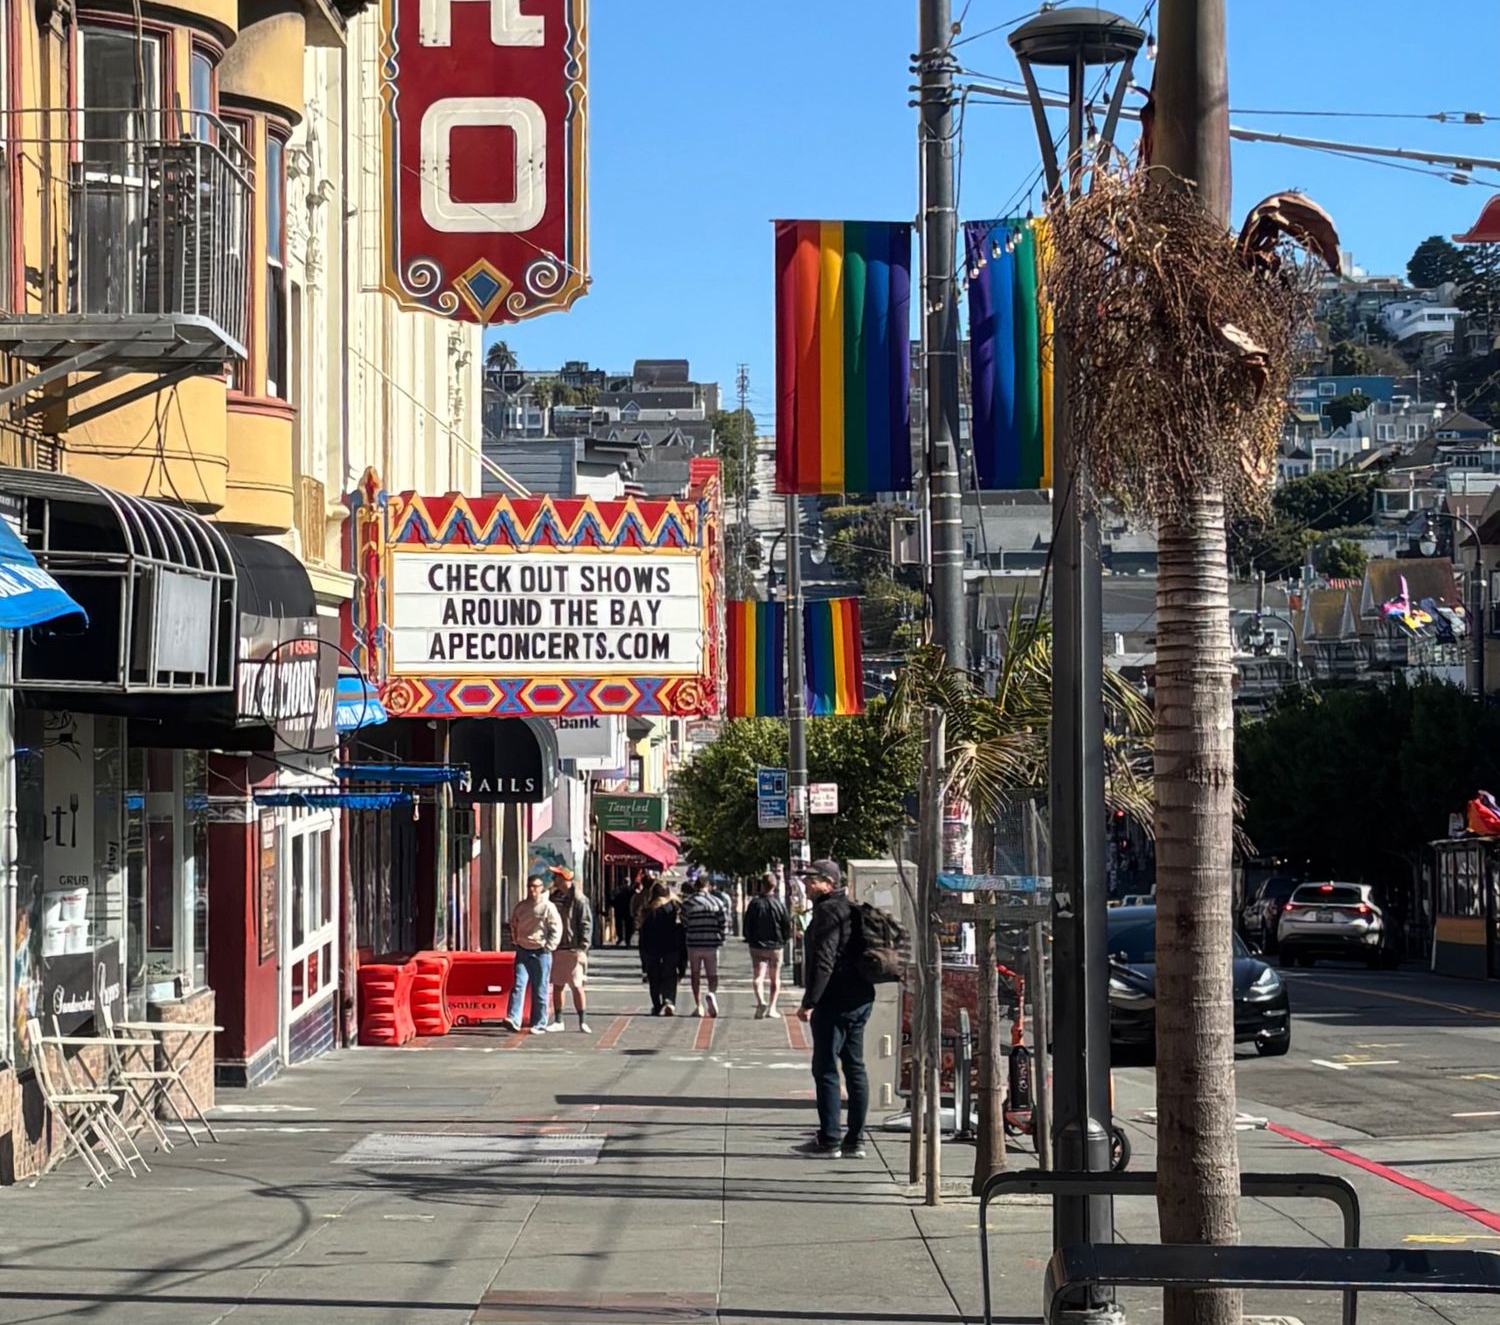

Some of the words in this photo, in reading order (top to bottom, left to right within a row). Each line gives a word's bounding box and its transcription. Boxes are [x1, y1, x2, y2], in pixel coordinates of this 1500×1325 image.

[428, 563, 512, 593] CHECK
[520, 565, 568, 593] OUT
[580, 566, 671, 593] SHOWS
[442, 597, 542, 626] AROUND
[550, 598, 598, 626] THE
[610, 599, 662, 626] BAY
[429, 632, 670, 660] APECONCERTS.COM
[459, 778, 535, 793] NAILS
[59, 875, 89, 886] GRUB
